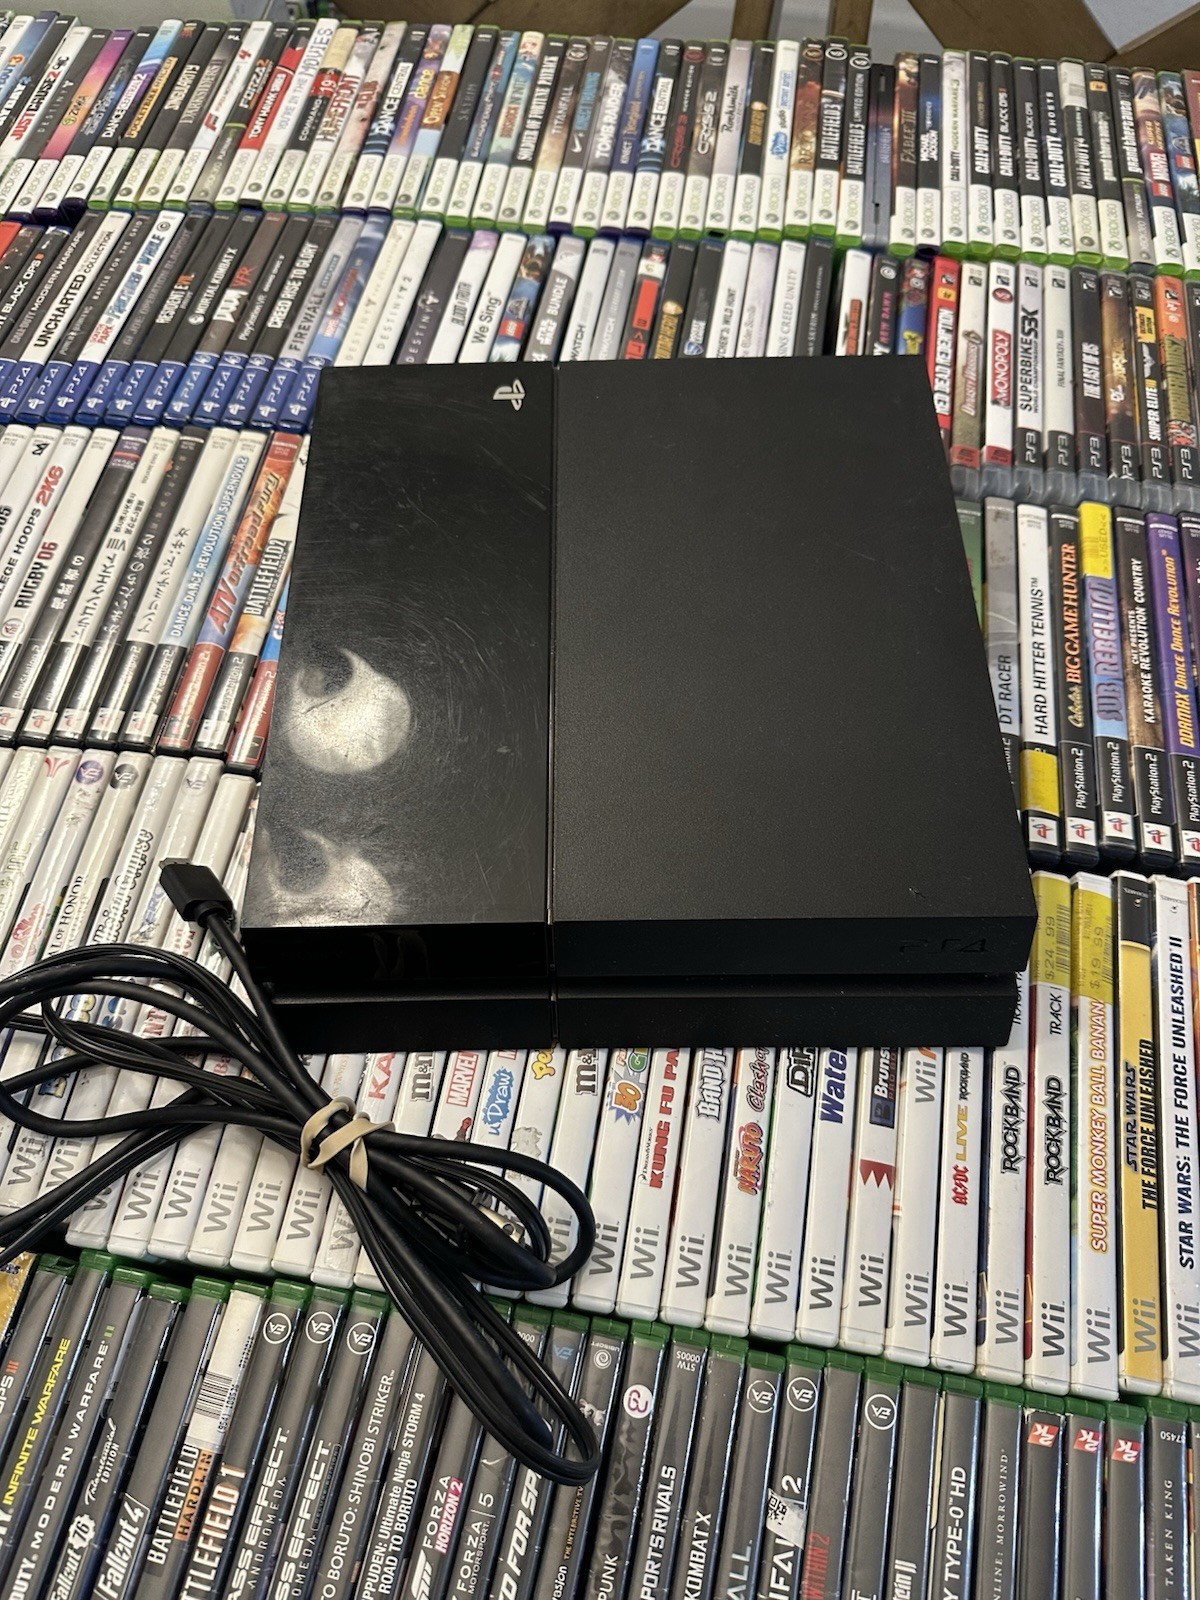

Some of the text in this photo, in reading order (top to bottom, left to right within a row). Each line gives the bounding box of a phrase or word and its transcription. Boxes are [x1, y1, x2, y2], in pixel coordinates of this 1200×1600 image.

[10, 111, 36, 141] JUST
[102, 108, 125, 138] DANCE
[3, 280, 28, 313] BLACK
[33, 273, 88, 348] UNCHARTED
[471, 297, 502, 345] We Sing
[546, 277, 568, 316] BUNDLE
[993, 332, 1012, 405] MONOPOLY
[1019, 337, 1034, 413] SUPERBIKE
[14, 465, 64, 555] HOOPS 2K6
[14, 560, 49, 609] RUGBY
[1131, 558, 1155, 724] KARAOKE REVOLUTION COUNTRY
[997, 655, 1013, 725] DT RACER
[1032, 640, 1049, 736] HARD HITTER
[1097, 680, 1124, 722] SUB
[1074, 758, 1089, 810] PlayStation
[1110, 752, 1125, 803] PlayStation
[1147, 763, 1162, 815] PlayStation
[1050, 993, 1062, 1035] TRACK
[650, 1085, 675, 1189] KUNG FU
[956, 1105, 969, 1161] LIVE
[1124, 1060, 1138, 1172] STAR WARS
[1138, 1038, 1158, 1210] THE FORCE UNLEASHED
[1170, 953, 1195, 1270] STAR WARS: THE FORCE UNLEASHED
[1091, 1065, 1107, 1252] SUPER MONKEY BALL
[124, 1169, 160, 1221] Wii
[164, 1169, 201, 1220] Wii
[203, 1180, 239, 1233] Wii
[246, 1181, 283, 1233] Wii
[286, 1187, 322, 1240] Wii
[589, 1222, 619, 1276] Wii
[630, 1226, 660, 1279] Wii
[676, 1234, 705, 1288] Wii
[725, 1243, 753, 1297] Wii
[765, 1250, 793, 1304] Wii
[809, 1255, 836, 1309] Wii
[3, 1338, 71, 1506] INFINITE WARFARE
[31, 1343, 109, 1550] MODERN WARFARE
[100, 1442, 121, 1484] EDITION
[245, 1427, 289, 1547] EFFECT
[378, 1391, 427, 1541] Ultimate Ninja STORM 4
[950, 1466, 966, 1498] HD
[147, 1443, 200, 1566] BATTLEFIELD
[247, 1476, 287, 1590] ANDROMEDA
[288, 1439, 331, 1559] EFFECT
[327, 1506, 359, 1582] BORUTO:
[348, 1437, 378, 1505] SHINOBI
[422, 1475, 452, 1549] FORZA
[435, 1493, 460, 1554] HORIZON
[652, 1465, 677, 1534] RIVALS
[995, 1453, 1009, 1546] MORROWIND
[97, 1501, 145, 1600] Fallout 4
[378, 1477, 418, 1595] ROAD TO BORUTO
[456, 1493, 495, 1593] FORZA 5
[507, 1509, 533, 1577] FOR
[1164, 1480, 1174, 1587] TAKEN KING
